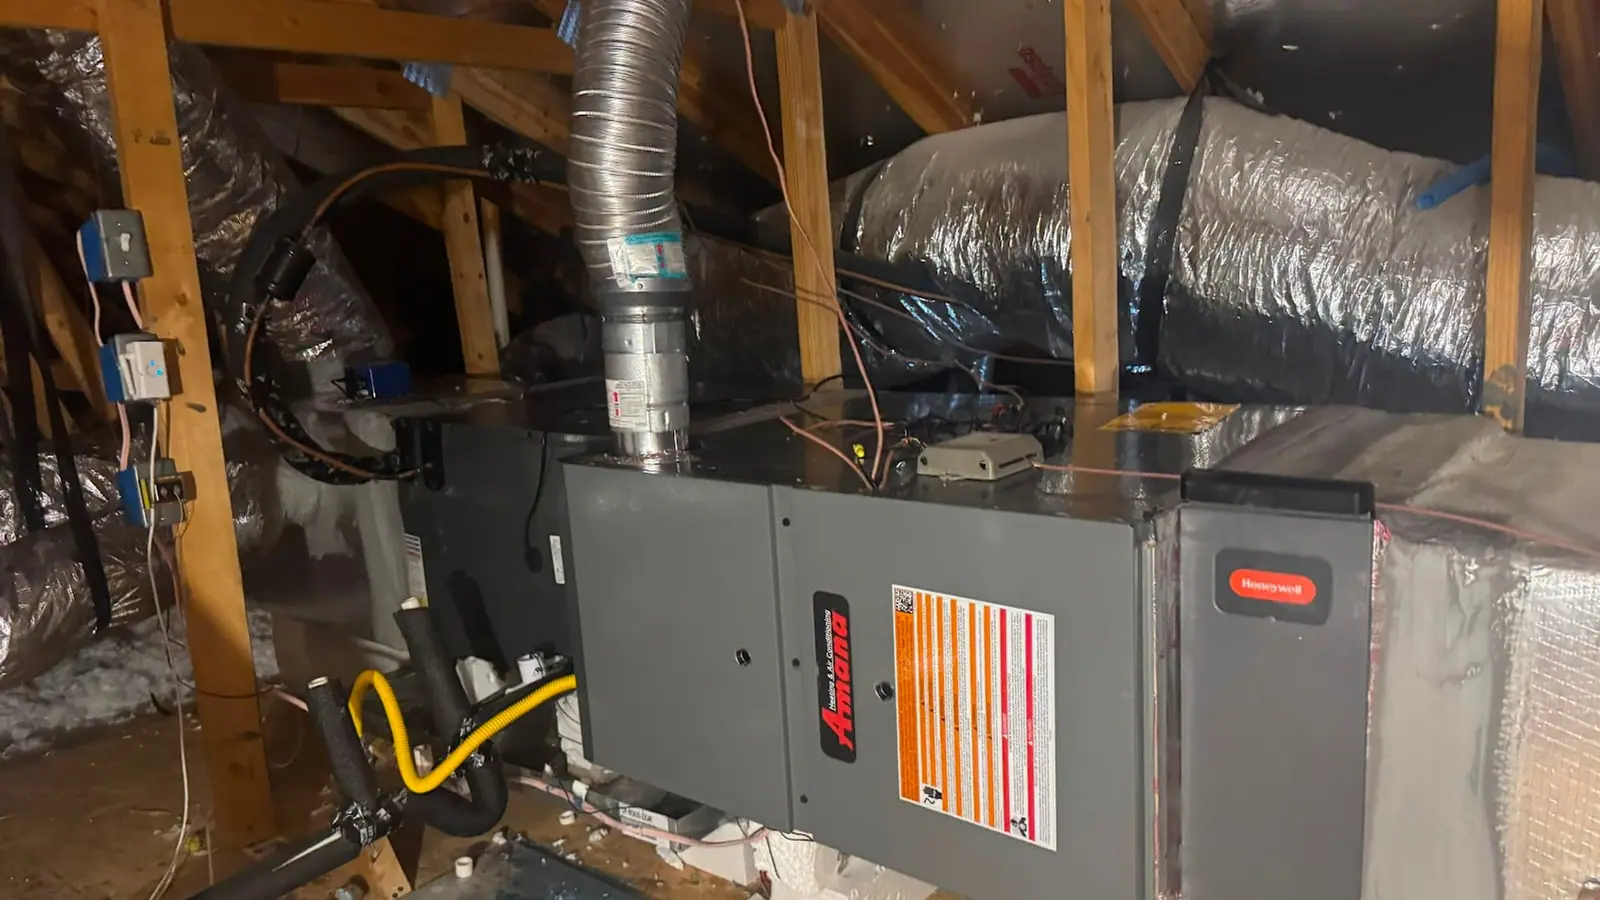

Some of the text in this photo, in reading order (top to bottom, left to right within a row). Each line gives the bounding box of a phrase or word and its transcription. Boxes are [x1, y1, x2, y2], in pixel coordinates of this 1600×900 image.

[1242, 578, 1302, 595] Honeywell
[824, 609, 832, 659] Conditioning
[822, 611, 853, 750] Amana
